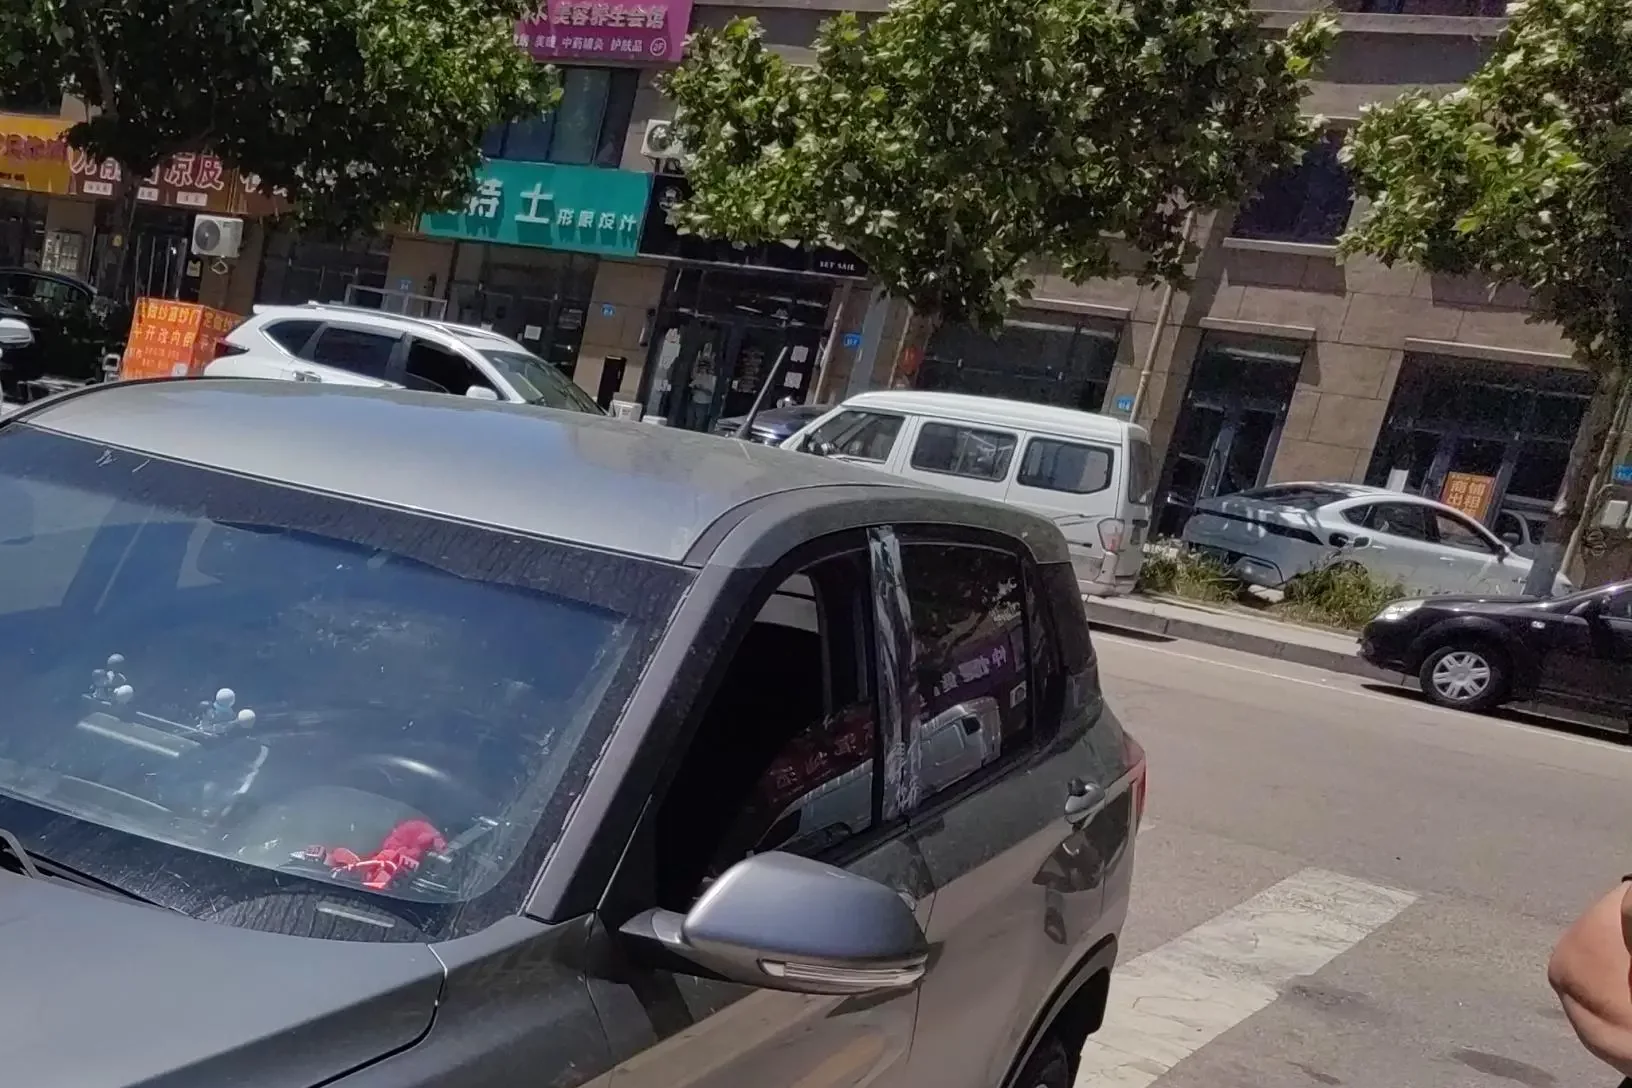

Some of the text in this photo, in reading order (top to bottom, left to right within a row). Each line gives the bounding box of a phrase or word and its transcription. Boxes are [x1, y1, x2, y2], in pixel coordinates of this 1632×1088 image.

[553, 2, 667, 29] 美容养生会馆
[556, 207, 637, 232] 形象设计
[1447, 493, 1481, 508] 出租
